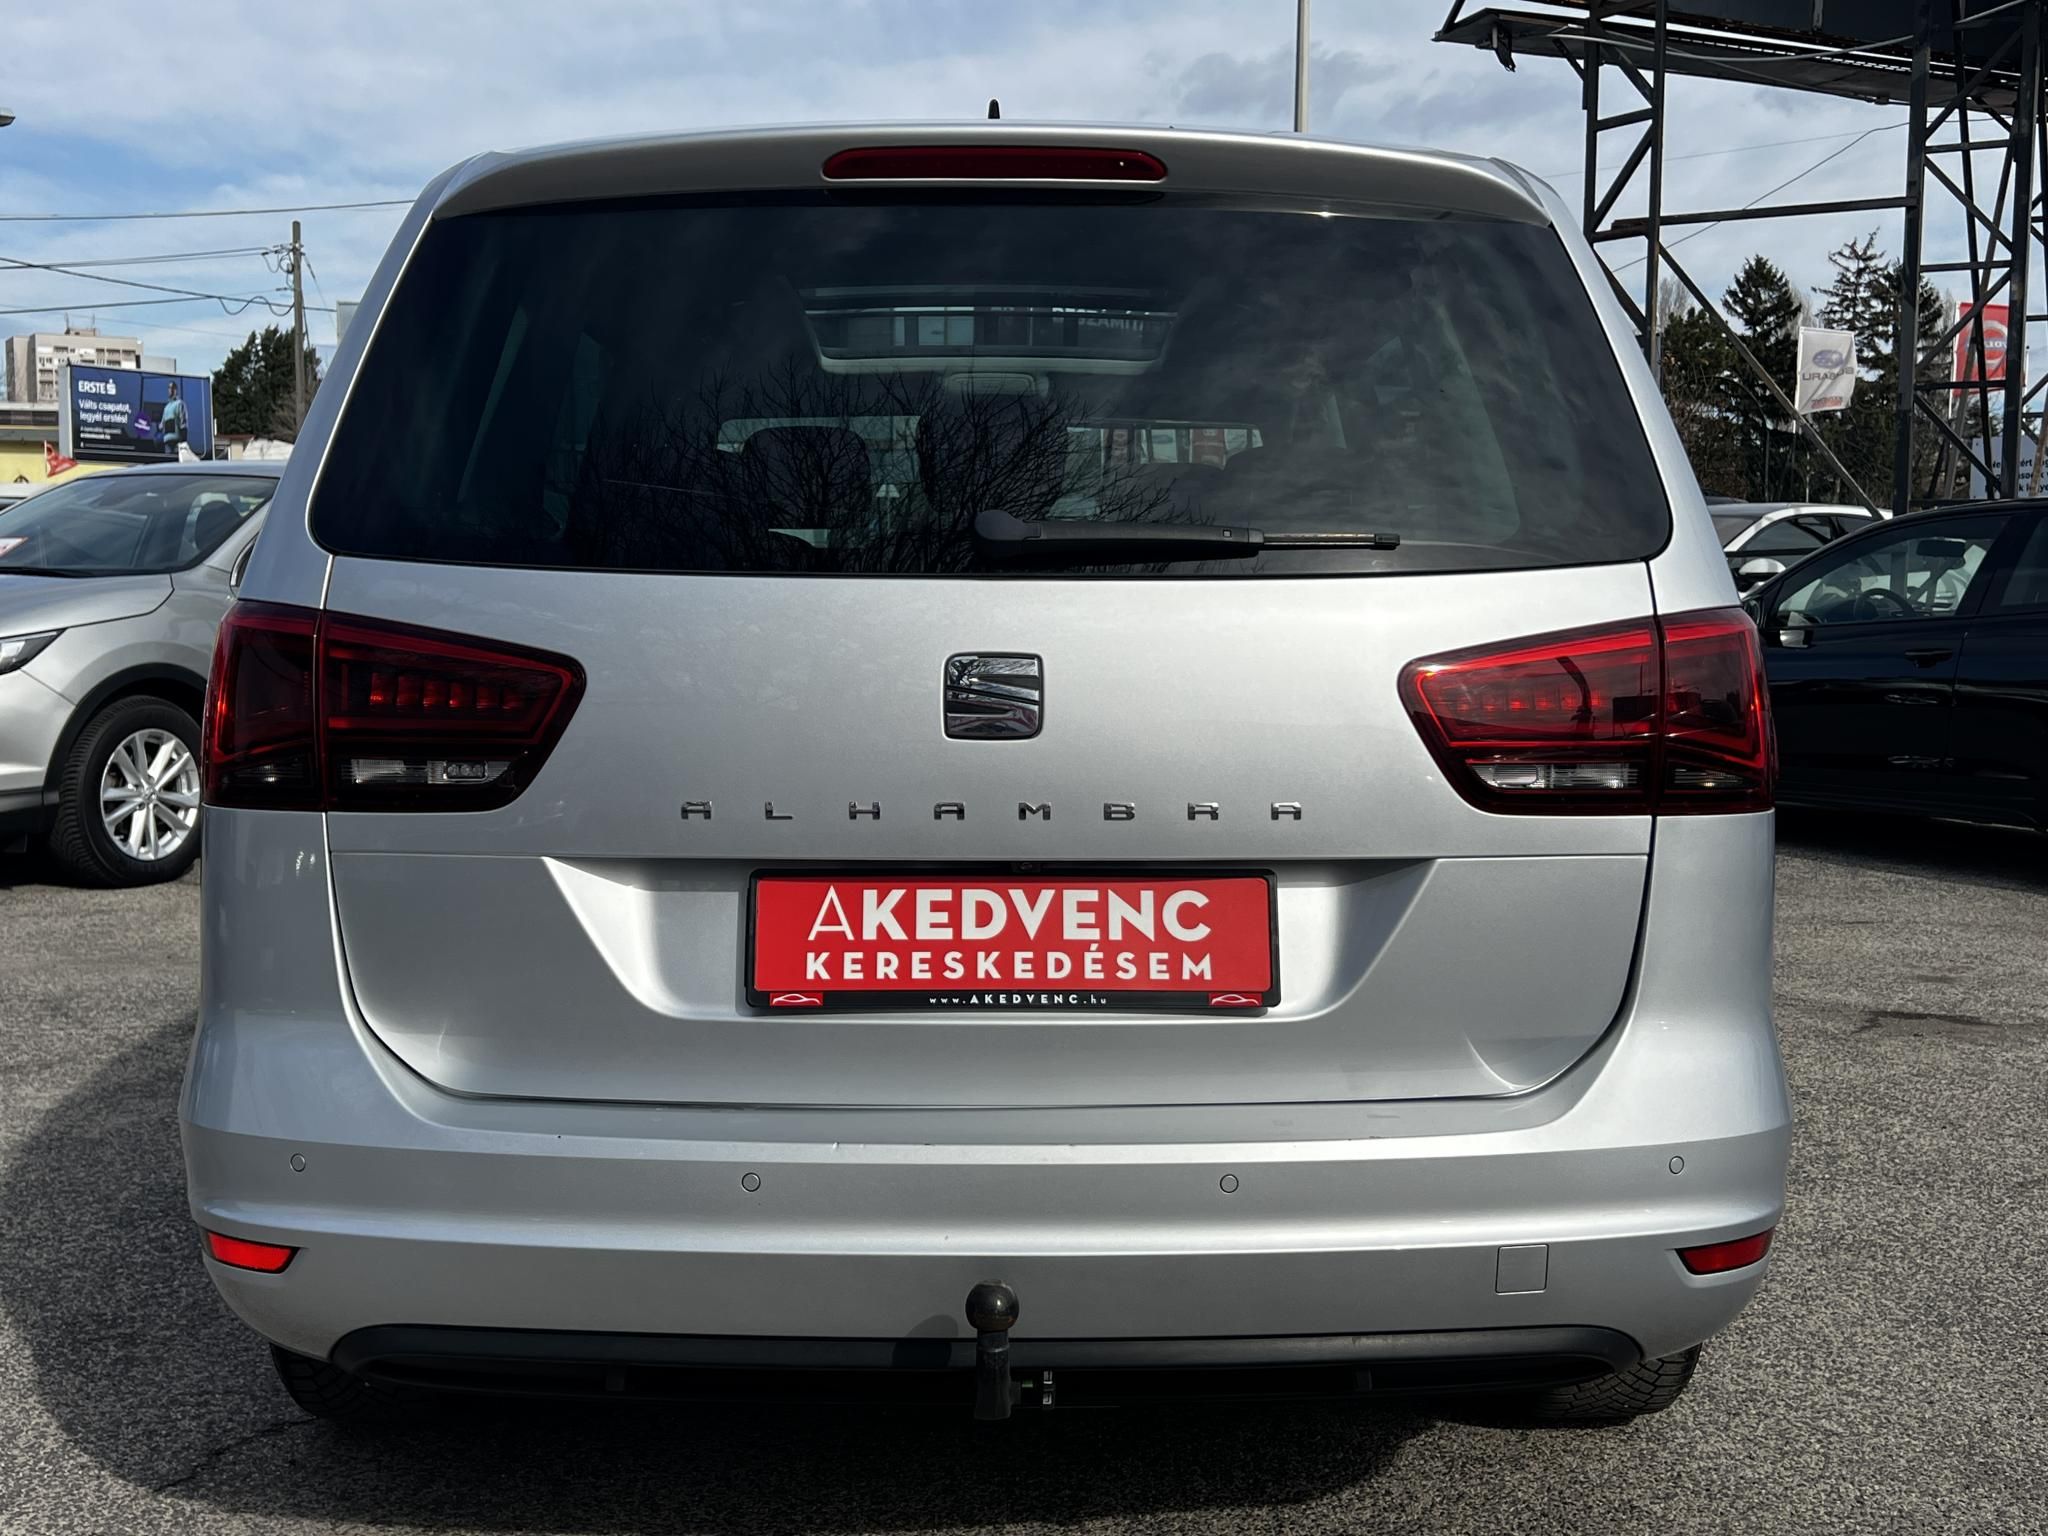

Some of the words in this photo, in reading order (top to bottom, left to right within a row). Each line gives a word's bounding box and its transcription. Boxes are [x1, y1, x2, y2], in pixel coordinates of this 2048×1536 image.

[78, 380, 106, 394] ERSTE
[680, 800, 1302, 821] ALHAMBRA
[808, 886, 1212, 942] AKEDVENC
[806, 943, 1213, 981] KERESKEDÉSEM
[929, 993, 1107, 1005] www.AKEDVENC.hu
